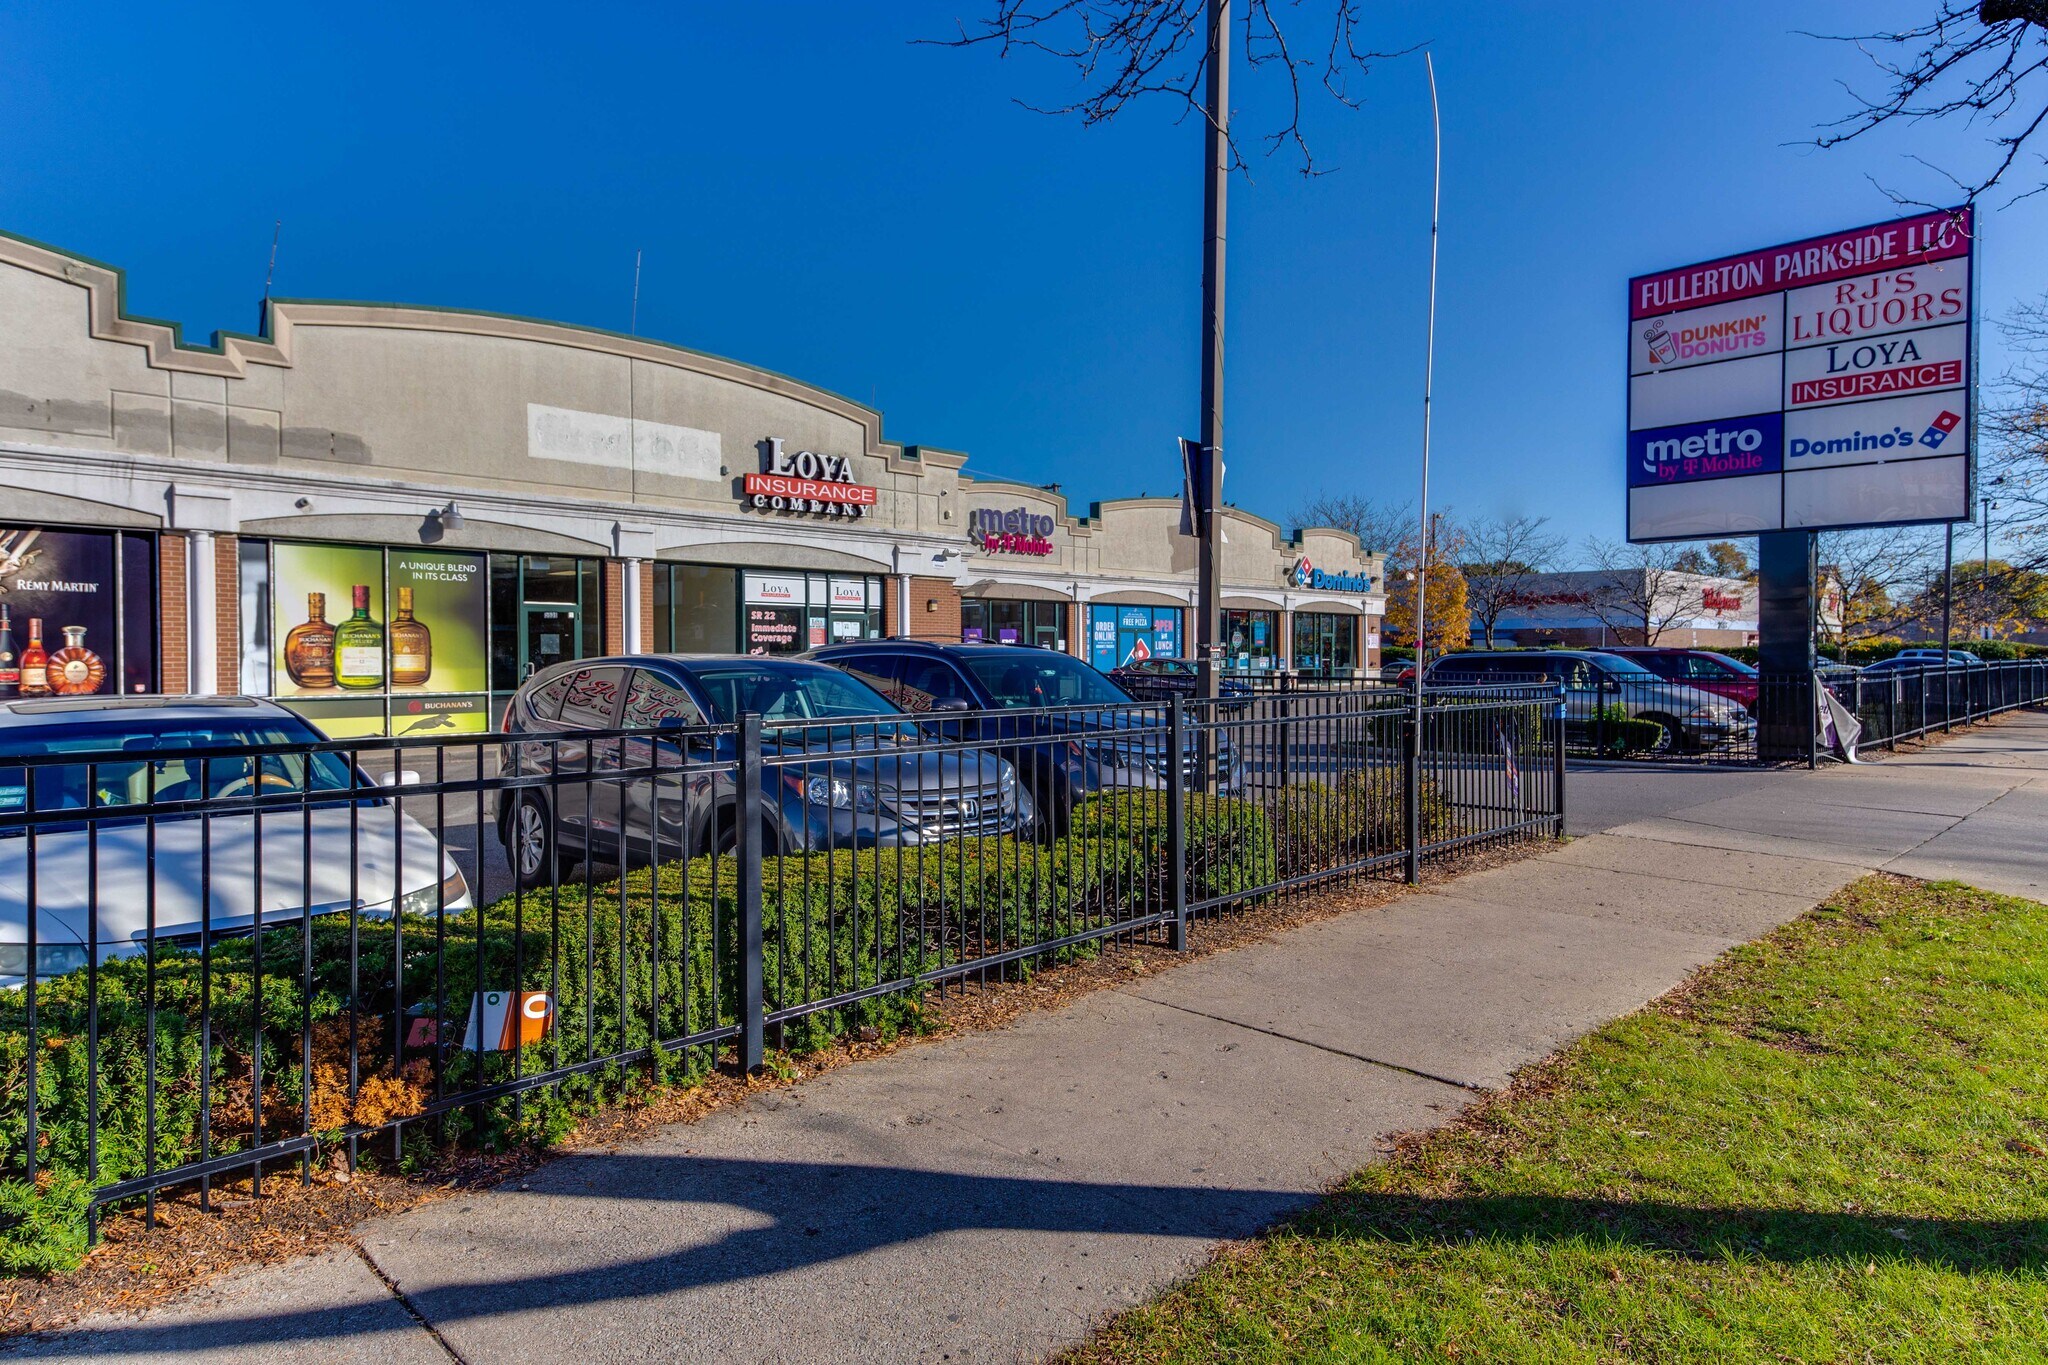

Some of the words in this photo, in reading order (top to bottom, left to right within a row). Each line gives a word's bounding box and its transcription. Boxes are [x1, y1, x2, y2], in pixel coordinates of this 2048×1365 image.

[1641, 259, 1764, 309] FULLERTON
[1774, 230, 1898, 282] PARKSIDE
[1907, 219, 1957, 256] LLC
[1835, 271, 1918, 305] RJ'S
[1792, 288, 1963, 342] LIQUORS
[1681, 315, 1767, 344] DUNKIN'
[1681, 331, 1766, 359] DONUTS
[1826, 339, 1922, 374] LOYA
[1795, 363, 1957, 402] INSURANCE
[1645, 428, 1763, 462] metro
[1789, 426, 1914, 458] Domino's
[767, 436, 857, 484] LOYA
[1659, 463, 1680, 480] by
[1702, 452, 1763, 474] Mobile
[749, 476, 875, 502] INSURANCE
[753, 493, 869, 517] COMPANY
[976, 506, 1055, 538] metro
[984, 533, 999, 554] by
[400, 561, 407, 569] A
[408, 562, 445, 571] UNIQUE
[447, 564, 477, 573] BLEND
[412, 572, 423, 580] IN
[425, 572, 438, 581] ITS
[440, 573, 468, 582] CLASS
[51, 580, 98, 593] MARTIN
[762, 583, 790, 594] LOYA
[836, 586, 861, 597] LOYA
[1313, 568, 1371, 593] Domino's
[751, 610, 763, 620] SR
[764, 611, 776, 620] 22
[1123, 618, 1134, 626] FREE
[1135, 618, 1148, 626] PIZZA
[1154, 619, 1174, 632] OPEN
[751, 623, 797, 633] Immediate
[1094, 631, 1116, 642] ONLINE
[1095, 621, 1115, 632] ORDER
[751, 633, 793, 644] Coverage
[1155, 641, 1173, 650] LUNCH
[424, 701, 473, 710] BUCHANAN'S
